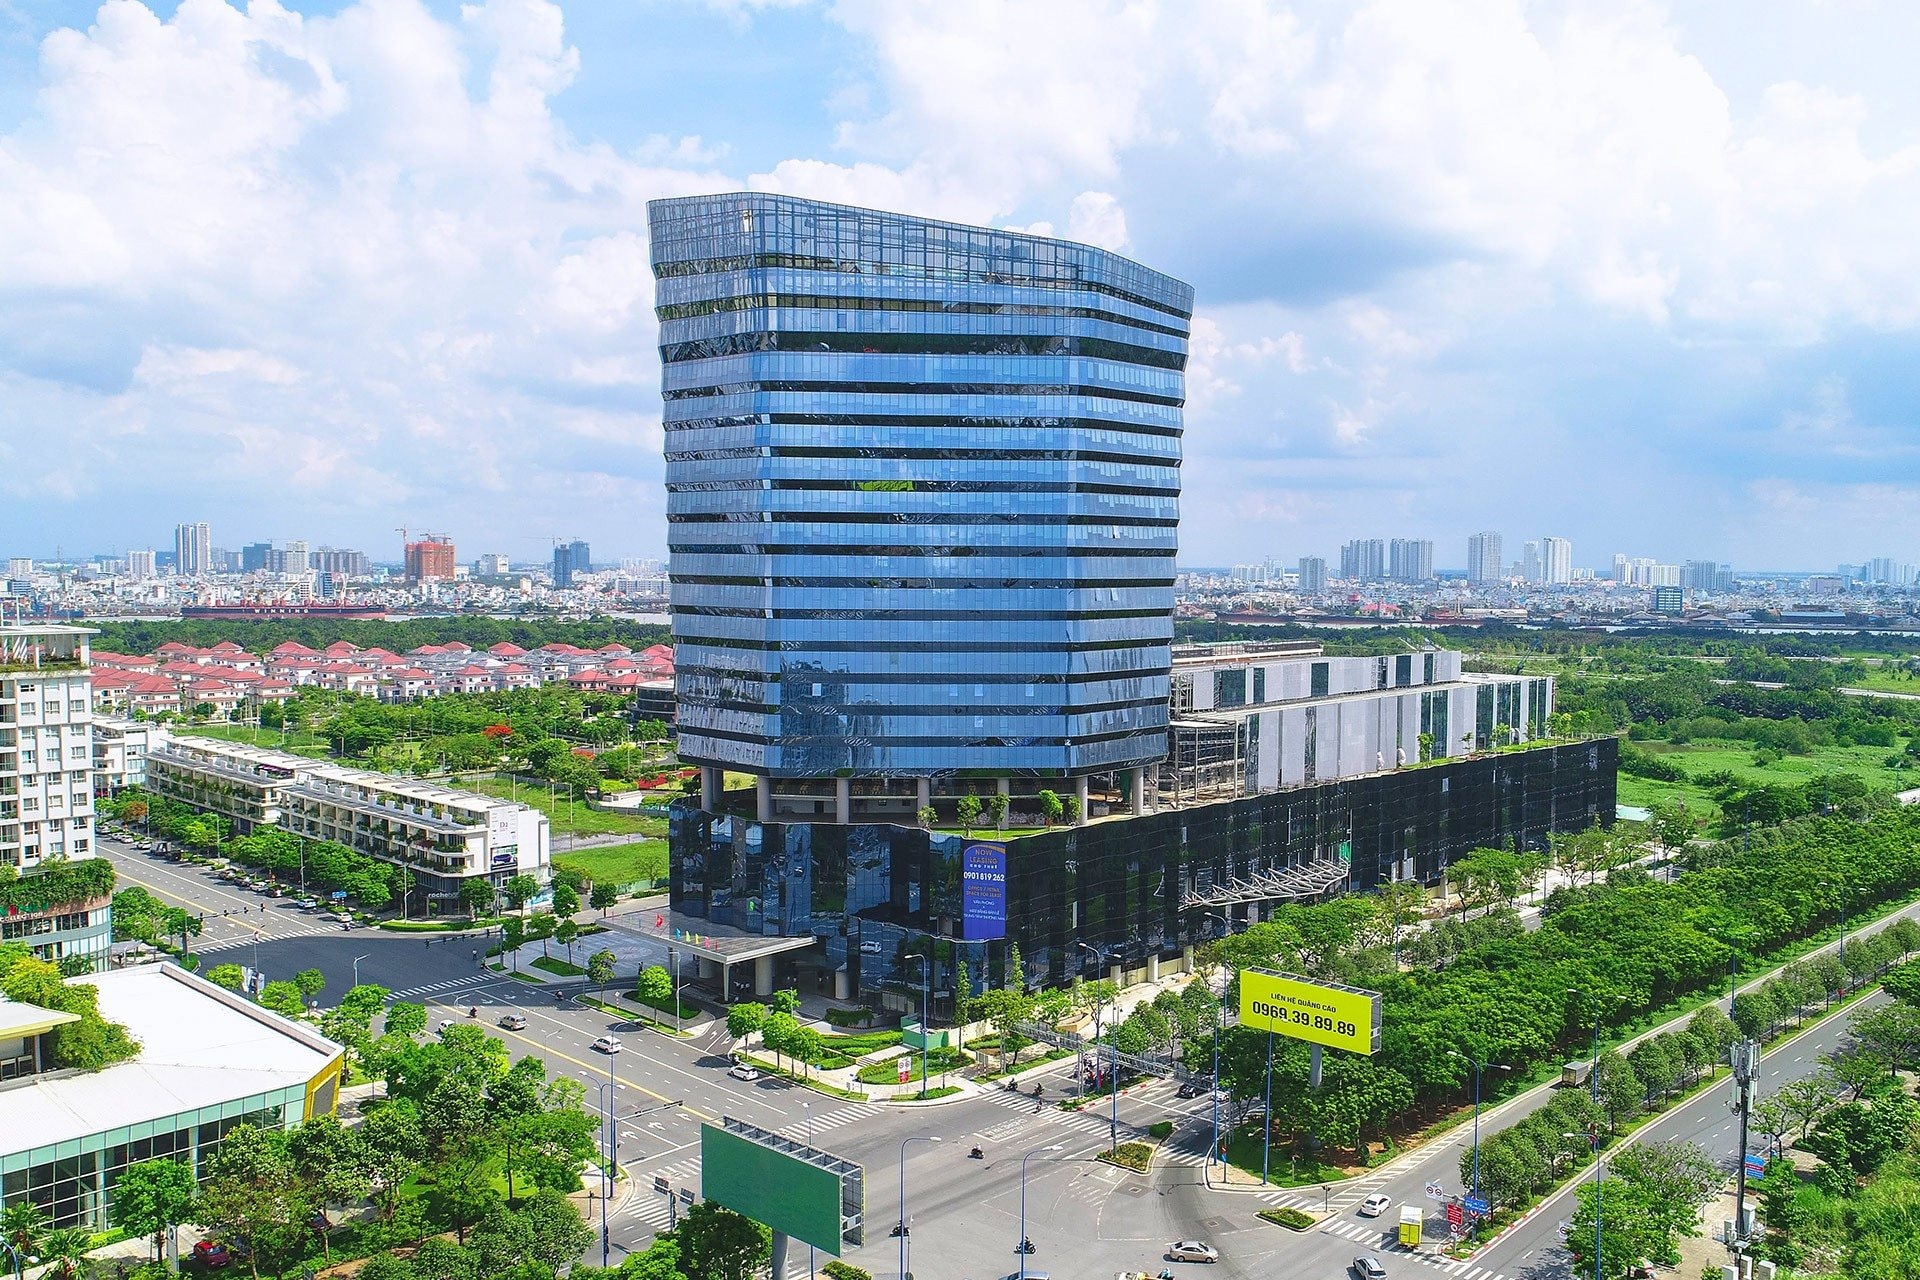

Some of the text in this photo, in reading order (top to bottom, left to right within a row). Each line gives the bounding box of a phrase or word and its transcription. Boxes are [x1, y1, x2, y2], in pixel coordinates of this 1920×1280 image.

[0, 912, 43, 922] COLLECTION
[1271, 993, 1336, 1013] LIÊN HỆ QUẢNG CÁO
[1253, 1002, 1355, 1036] 0969.39.89.89
